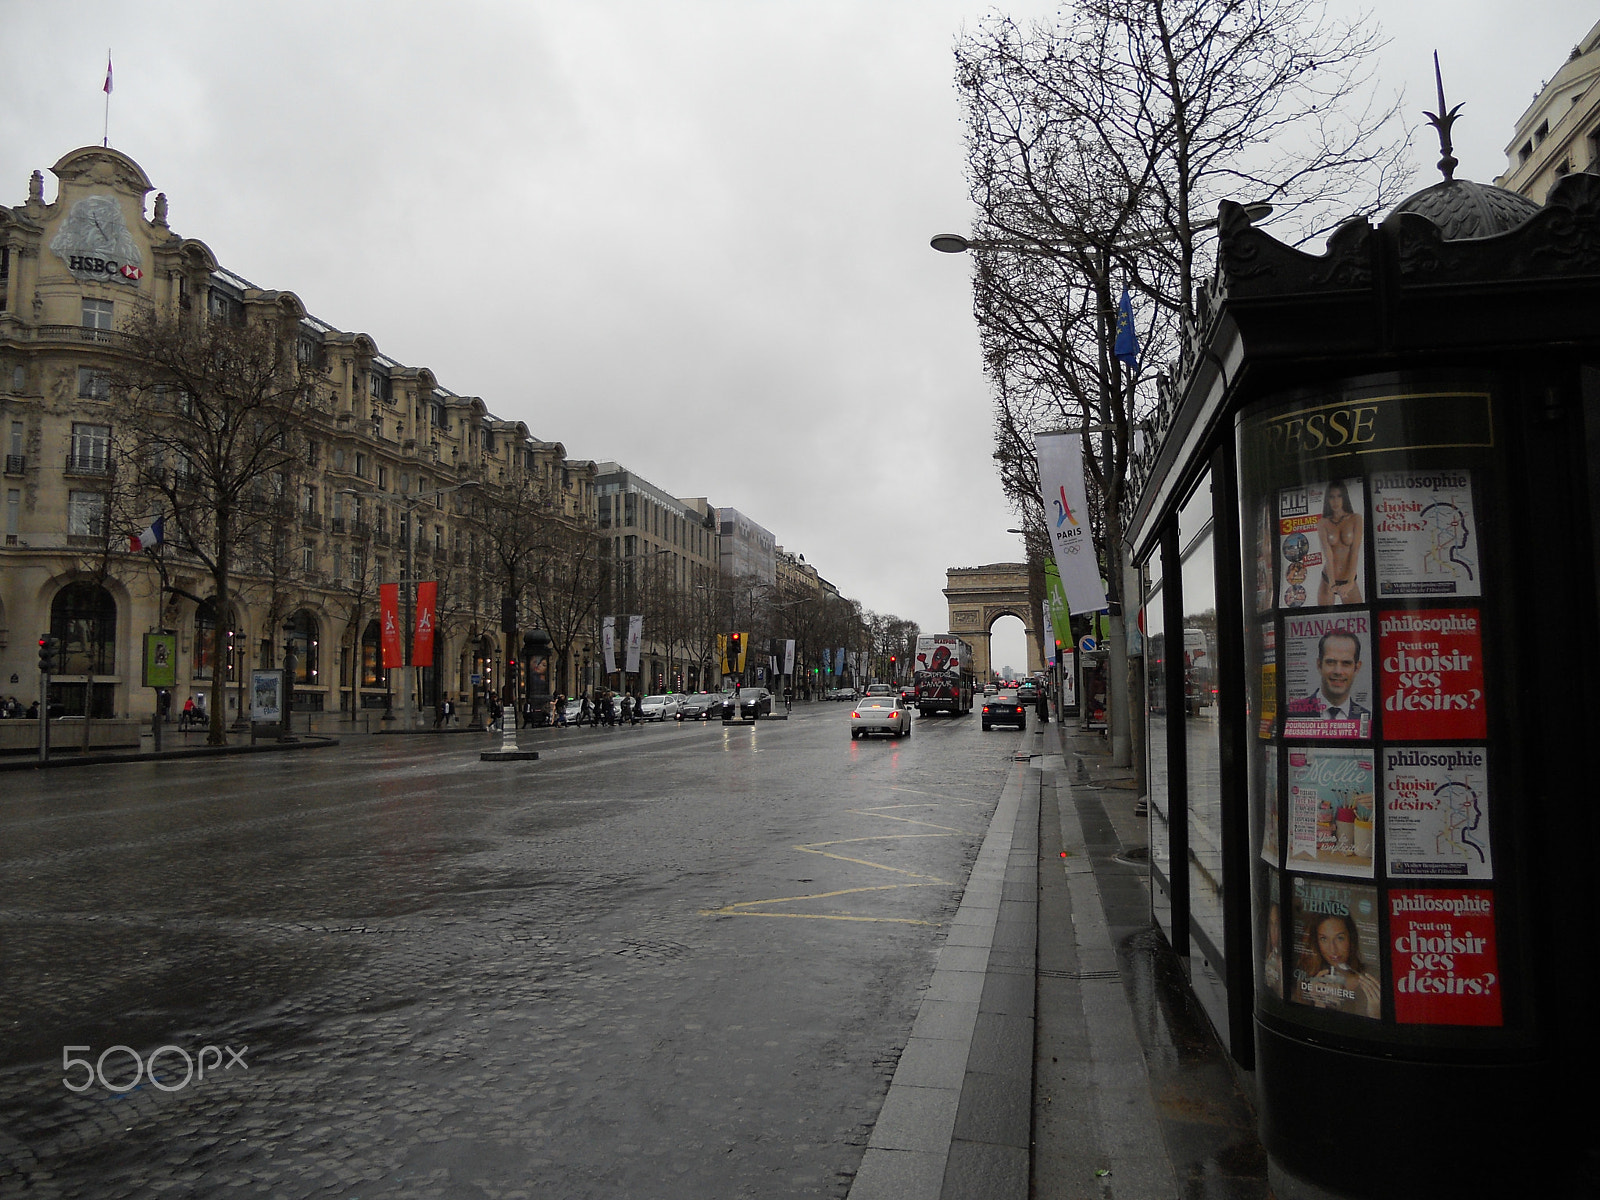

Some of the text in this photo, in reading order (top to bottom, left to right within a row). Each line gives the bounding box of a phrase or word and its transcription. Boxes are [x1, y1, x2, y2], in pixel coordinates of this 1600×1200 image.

[70, 255, 119, 275] HSBC
[1374, 471, 1467, 494] philosophie
[1375, 500, 1423, 513] choisir
[1385, 512, 1406, 520] ses
[1057, 527, 1082, 541] PARIS
[1283, 517, 1318, 533] 3 FILMS
[1377, 520, 1428, 533] désirs?
[1290, 618, 1367, 637] MANAGER
[1380, 614, 1477, 637] philosophie
[1397, 641, 1439, 651] Peut-on
[1383, 649, 1473, 673] choisir
[1398, 671, 1442, 688] ses
[1385, 688, 1481, 711] désirs?
[1388, 751, 1482, 771] philosophie
[1295, 759, 1368, 786] Mollie
[1388, 779, 1437, 791] choisir
[1398, 790, 1418, 798] ses
[1388, 799, 1441, 811] désirs?
[1294, 884, 1352, 903] SIMPLE
[1302, 898, 1350, 917] THINGS
[1392, 894, 1490, 916] philosophie
[1395, 931, 1487, 954] choisir
[1410, 953, 1454, 971] ses
[1301, 982, 1313, 991] DE
[1397, 970, 1496, 995] désirs?
